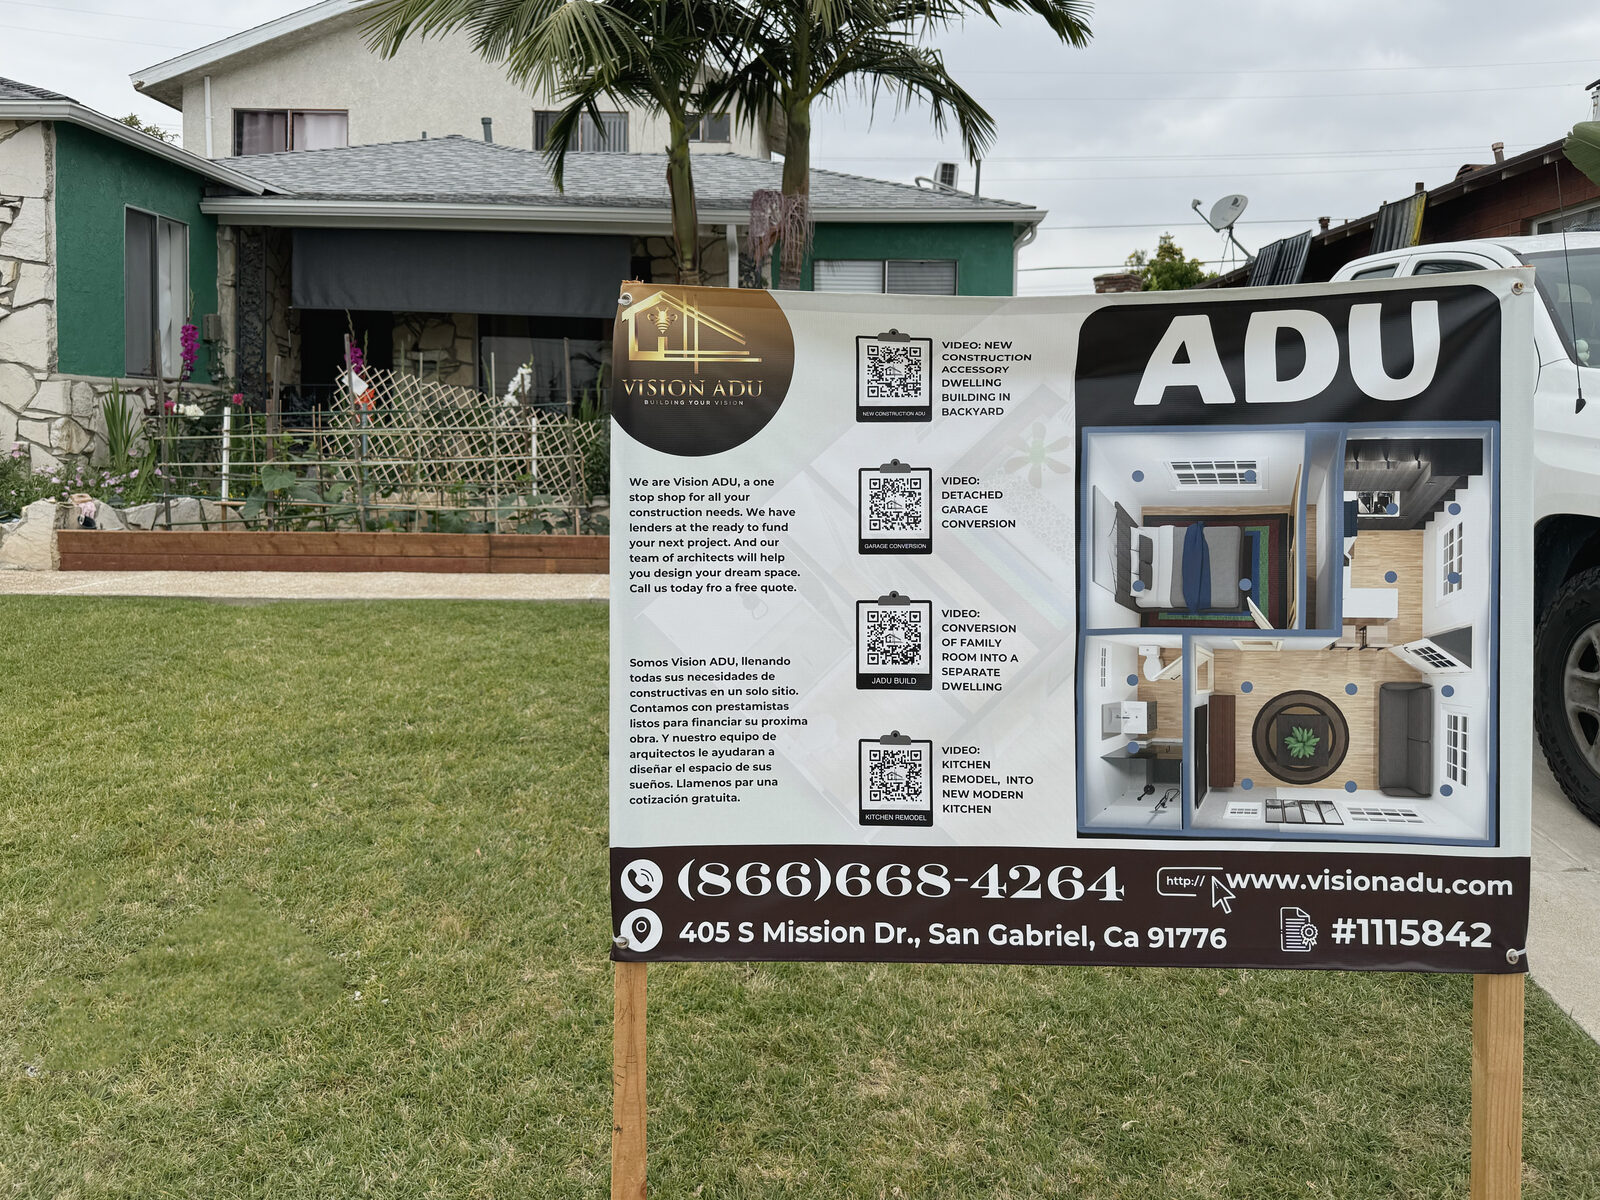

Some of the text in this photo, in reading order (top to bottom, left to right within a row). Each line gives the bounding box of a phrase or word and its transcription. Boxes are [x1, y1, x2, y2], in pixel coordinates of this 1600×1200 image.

[941, 341, 1013, 350] VIDEO: NEW
[941, 353, 1032, 362] CONSTRUCTION
[1133, 300, 1441, 406] ADU
[941, 365, 1010, 374] ACCESSORY
[621, 378, 764, 397] VISION ADU
[941, 378, 1002, 388] DWELLING
[941, 392, 1011, 402] BUILDING IN
[941, 407, 1004, 417] BACKYARD
[629, 476, 775, 488] We are Vision ADU, a one
[941, 476, 980, 485] VIDEO:
[629, 492, 751, 504] stop shop for all your
[941, 490, 1004, 500] DETACHED
[629, 507, 796, 517] construction needs. We have
[941, 505, 988, 514] GARAGE
[629, 522, 789, 534] lenders at the ready to fund
[941, 519, 1016, 529] CONVERSION
[629, 537, 780, 550] your next project. And our
[629, 552, 785, 564] team of architects will help
[629, 567, 801, 580] you design your dream space.
[629, 583, 651, 593] Call
[654, 585, 668, 593] us
[670, 583, 704, 595] today
[705, 582, 723, 592] fro
[734, 582, 758, 592] free
[760, 583, 797, 594] quote.
[941, 609, 980, 618] VIDEO:
[941, 623, 1017, 633] CONVERSION
[941, 638, 1002, 648] OF FAMILY
[629, 656, 791, 668] Somos Vision ADU, llenando
[942, 652, 1019, 663] ROOM INTO A
[629, 671, 776, 683] todas sus necesidades de
[941, 667, 1001, 677] SEPARATE
[871, 677, 917, 685] JADU BUILD
[942, 682, 1002, 692] DWELLING
[629, 686, 799, 698] constructivas en un solo sitio.
[629, 701, 790, 714] Contamos con prestamistas
[629, 715, 808, 730] listos para financiar su proxima
[629, 731, 777, 744] obra. Y nuestro equipo de
[629, 747, 775, 761] arquitectos le ayudaran a
[941, 746, 980, 755] VIDEO:
[629, 762, 772, 775] diseñar el espacio de sus
[942, 760, 991, 769] KITCHEN
[629, 778, 778, 790] sueños. Llamenos par una
[942, 774, 1034, 786] REMODEL, INTO
[629, 792, 741, 805] cotización gratuita.
[942, 789, 1024, 799] NEW MODERN
[942, 804, 992, 814] KITCHEN
[865, 813, 927, 822] KITCHEN REMODEL
[677, 857, 1125, 902] (866)668-4264
[1166, 875, 1206, 888] http://
[1224, 868, 1514, 896] www.visionadu.com
[679, 919, 1227, 952] 405 S Mission Dr., San Gabriel, Ca 91776
[1331, 917, 1492, 948] #1115842
